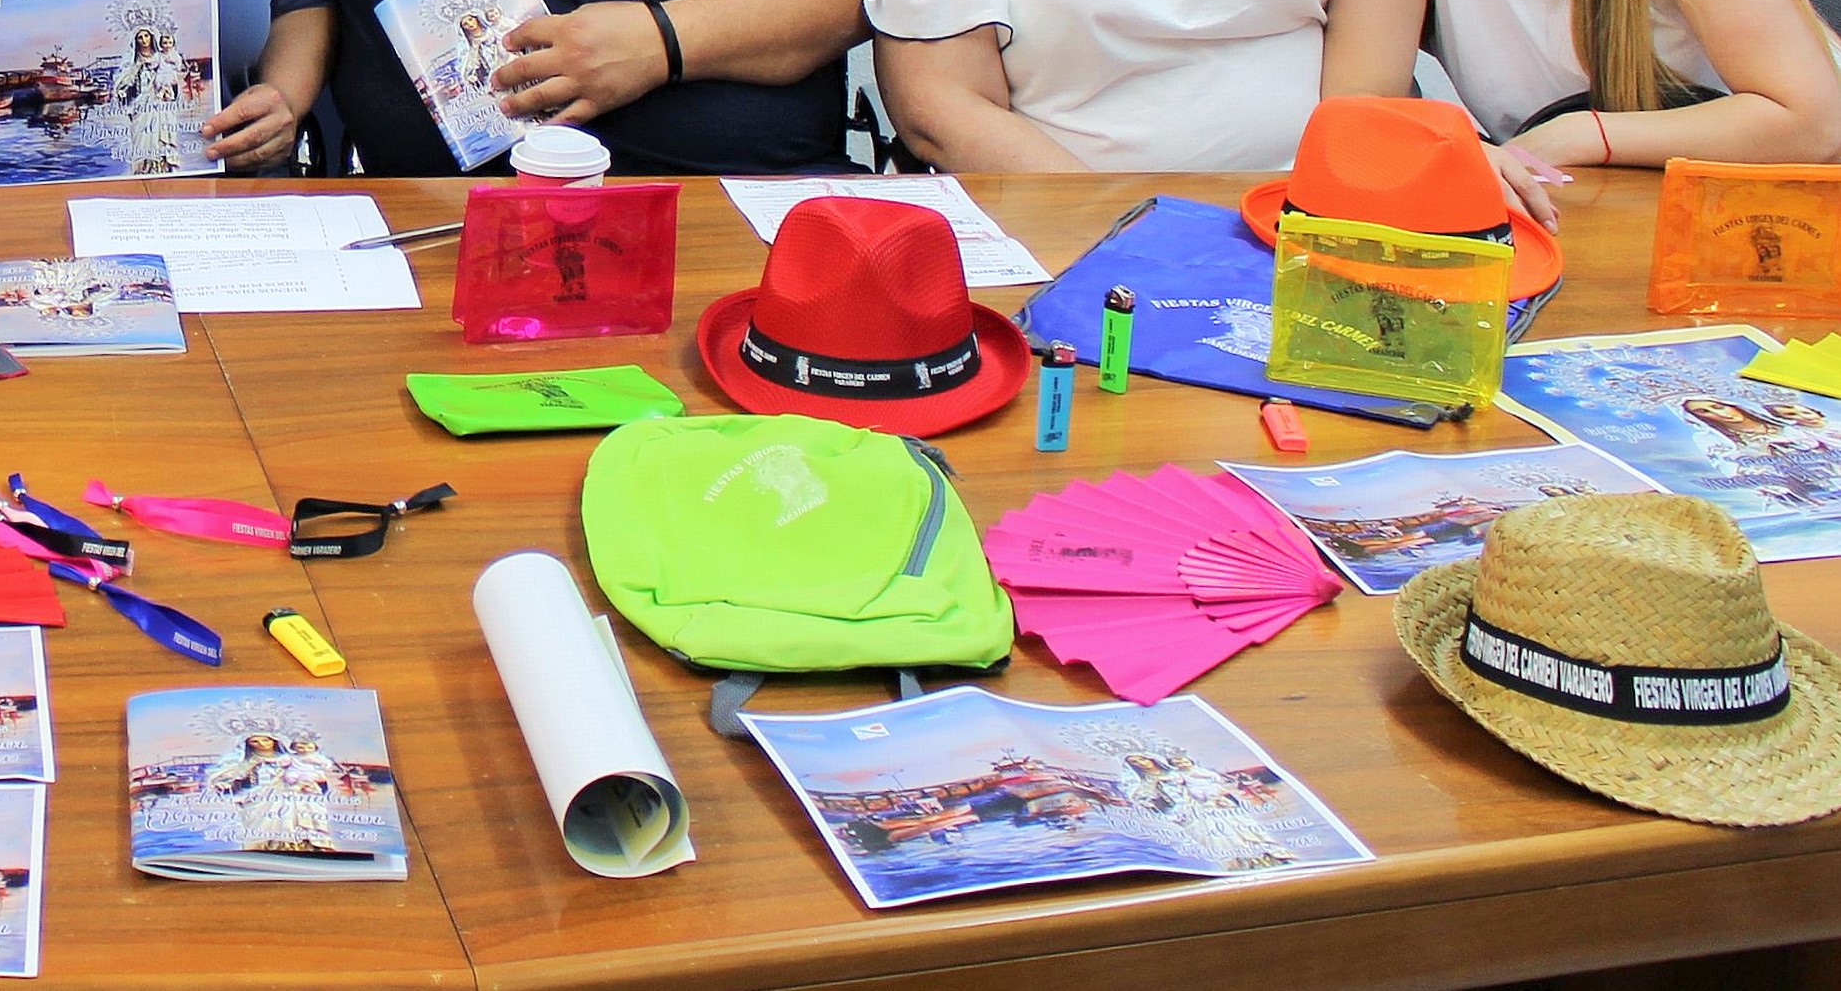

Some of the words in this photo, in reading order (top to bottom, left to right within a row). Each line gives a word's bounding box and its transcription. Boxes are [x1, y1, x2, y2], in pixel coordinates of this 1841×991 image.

[1713, 217, 1744, 237] FIESTAS
[1775, 215, 1790, 226] DEL
[1150, 298, 1221, 309] FIESTAS
[1224, 297, 1272, 314] VIRGE
[1290, 312, 1318, 327] DEL
[703, 463, 744, 503] FIESTAS
[1520, 648, 1558, 690] CARMEN
[1559, 660, 1614, 704] VARADERO
[1633, 676, 1681, 711] FIESTAS
[1681, 678, 1724, 711] VIRGEN
[1724, 677, 1745, 708] DEL
